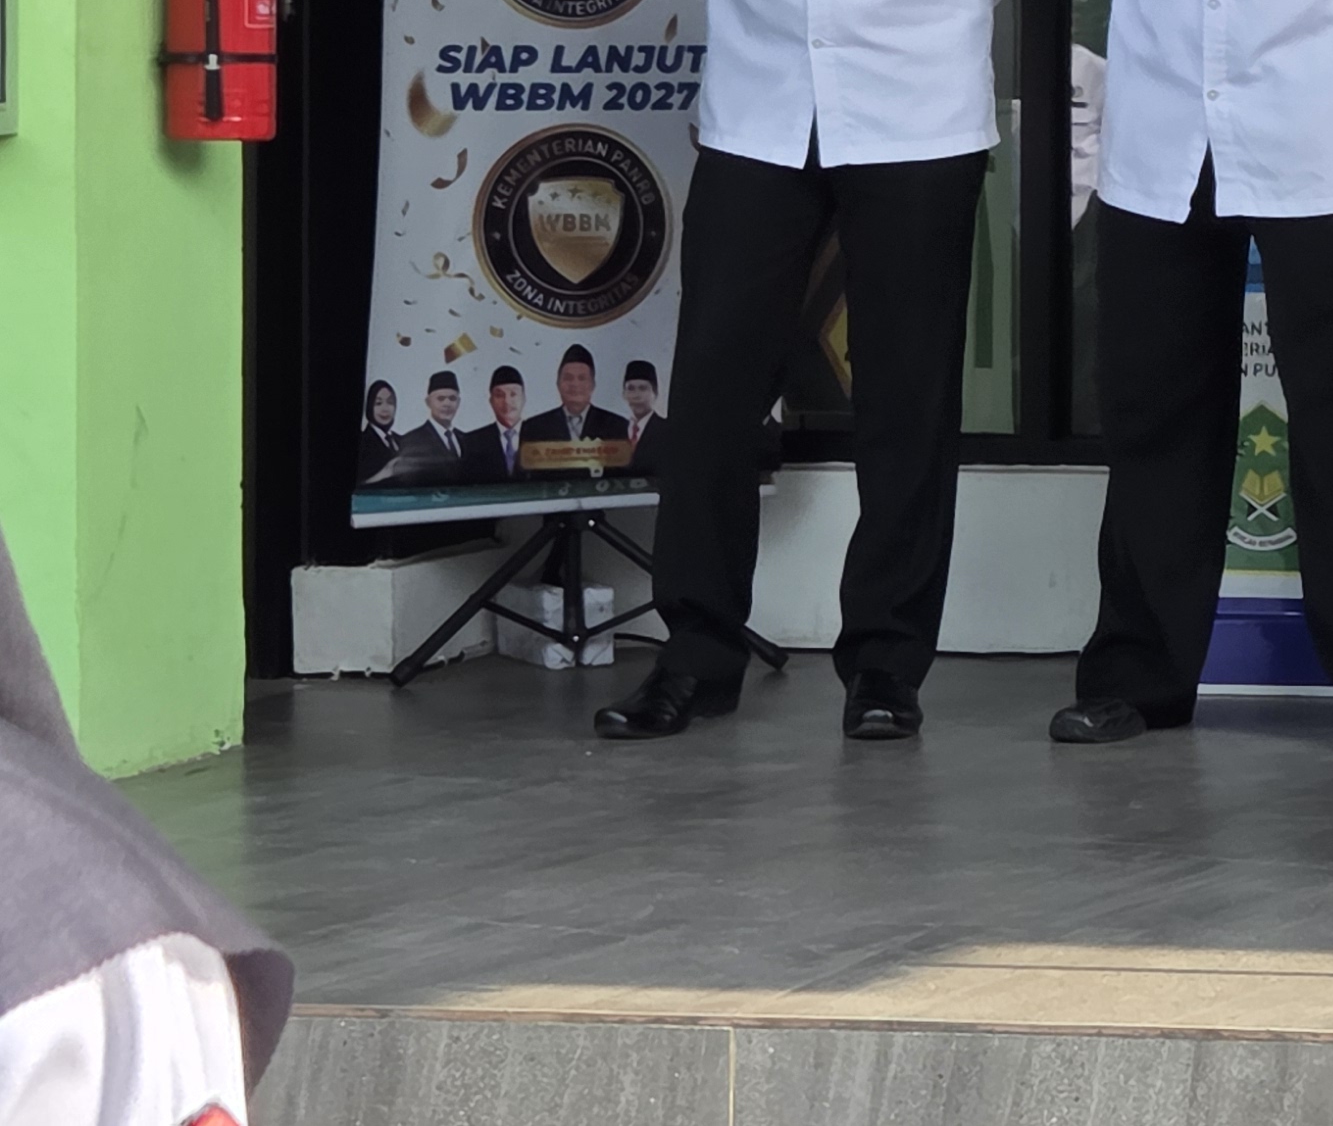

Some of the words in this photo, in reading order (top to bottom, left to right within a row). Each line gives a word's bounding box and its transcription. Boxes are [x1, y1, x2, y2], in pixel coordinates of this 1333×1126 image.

[436, 44, 539, 74] SIAP
[550, 44, 708, 74] LANJUT
[450, 81, 594, 111] WBBM
[601, 81, 700, 111] 2027
[491, 137, 610, 210] KEMENTERIAN
[611, 146, 656, 206] PANRB
[537, 212, 612, 233] WBBM
[505, 269, 545, 308] ZONA
[547, 273, 642, 315] INTEGRITAS
